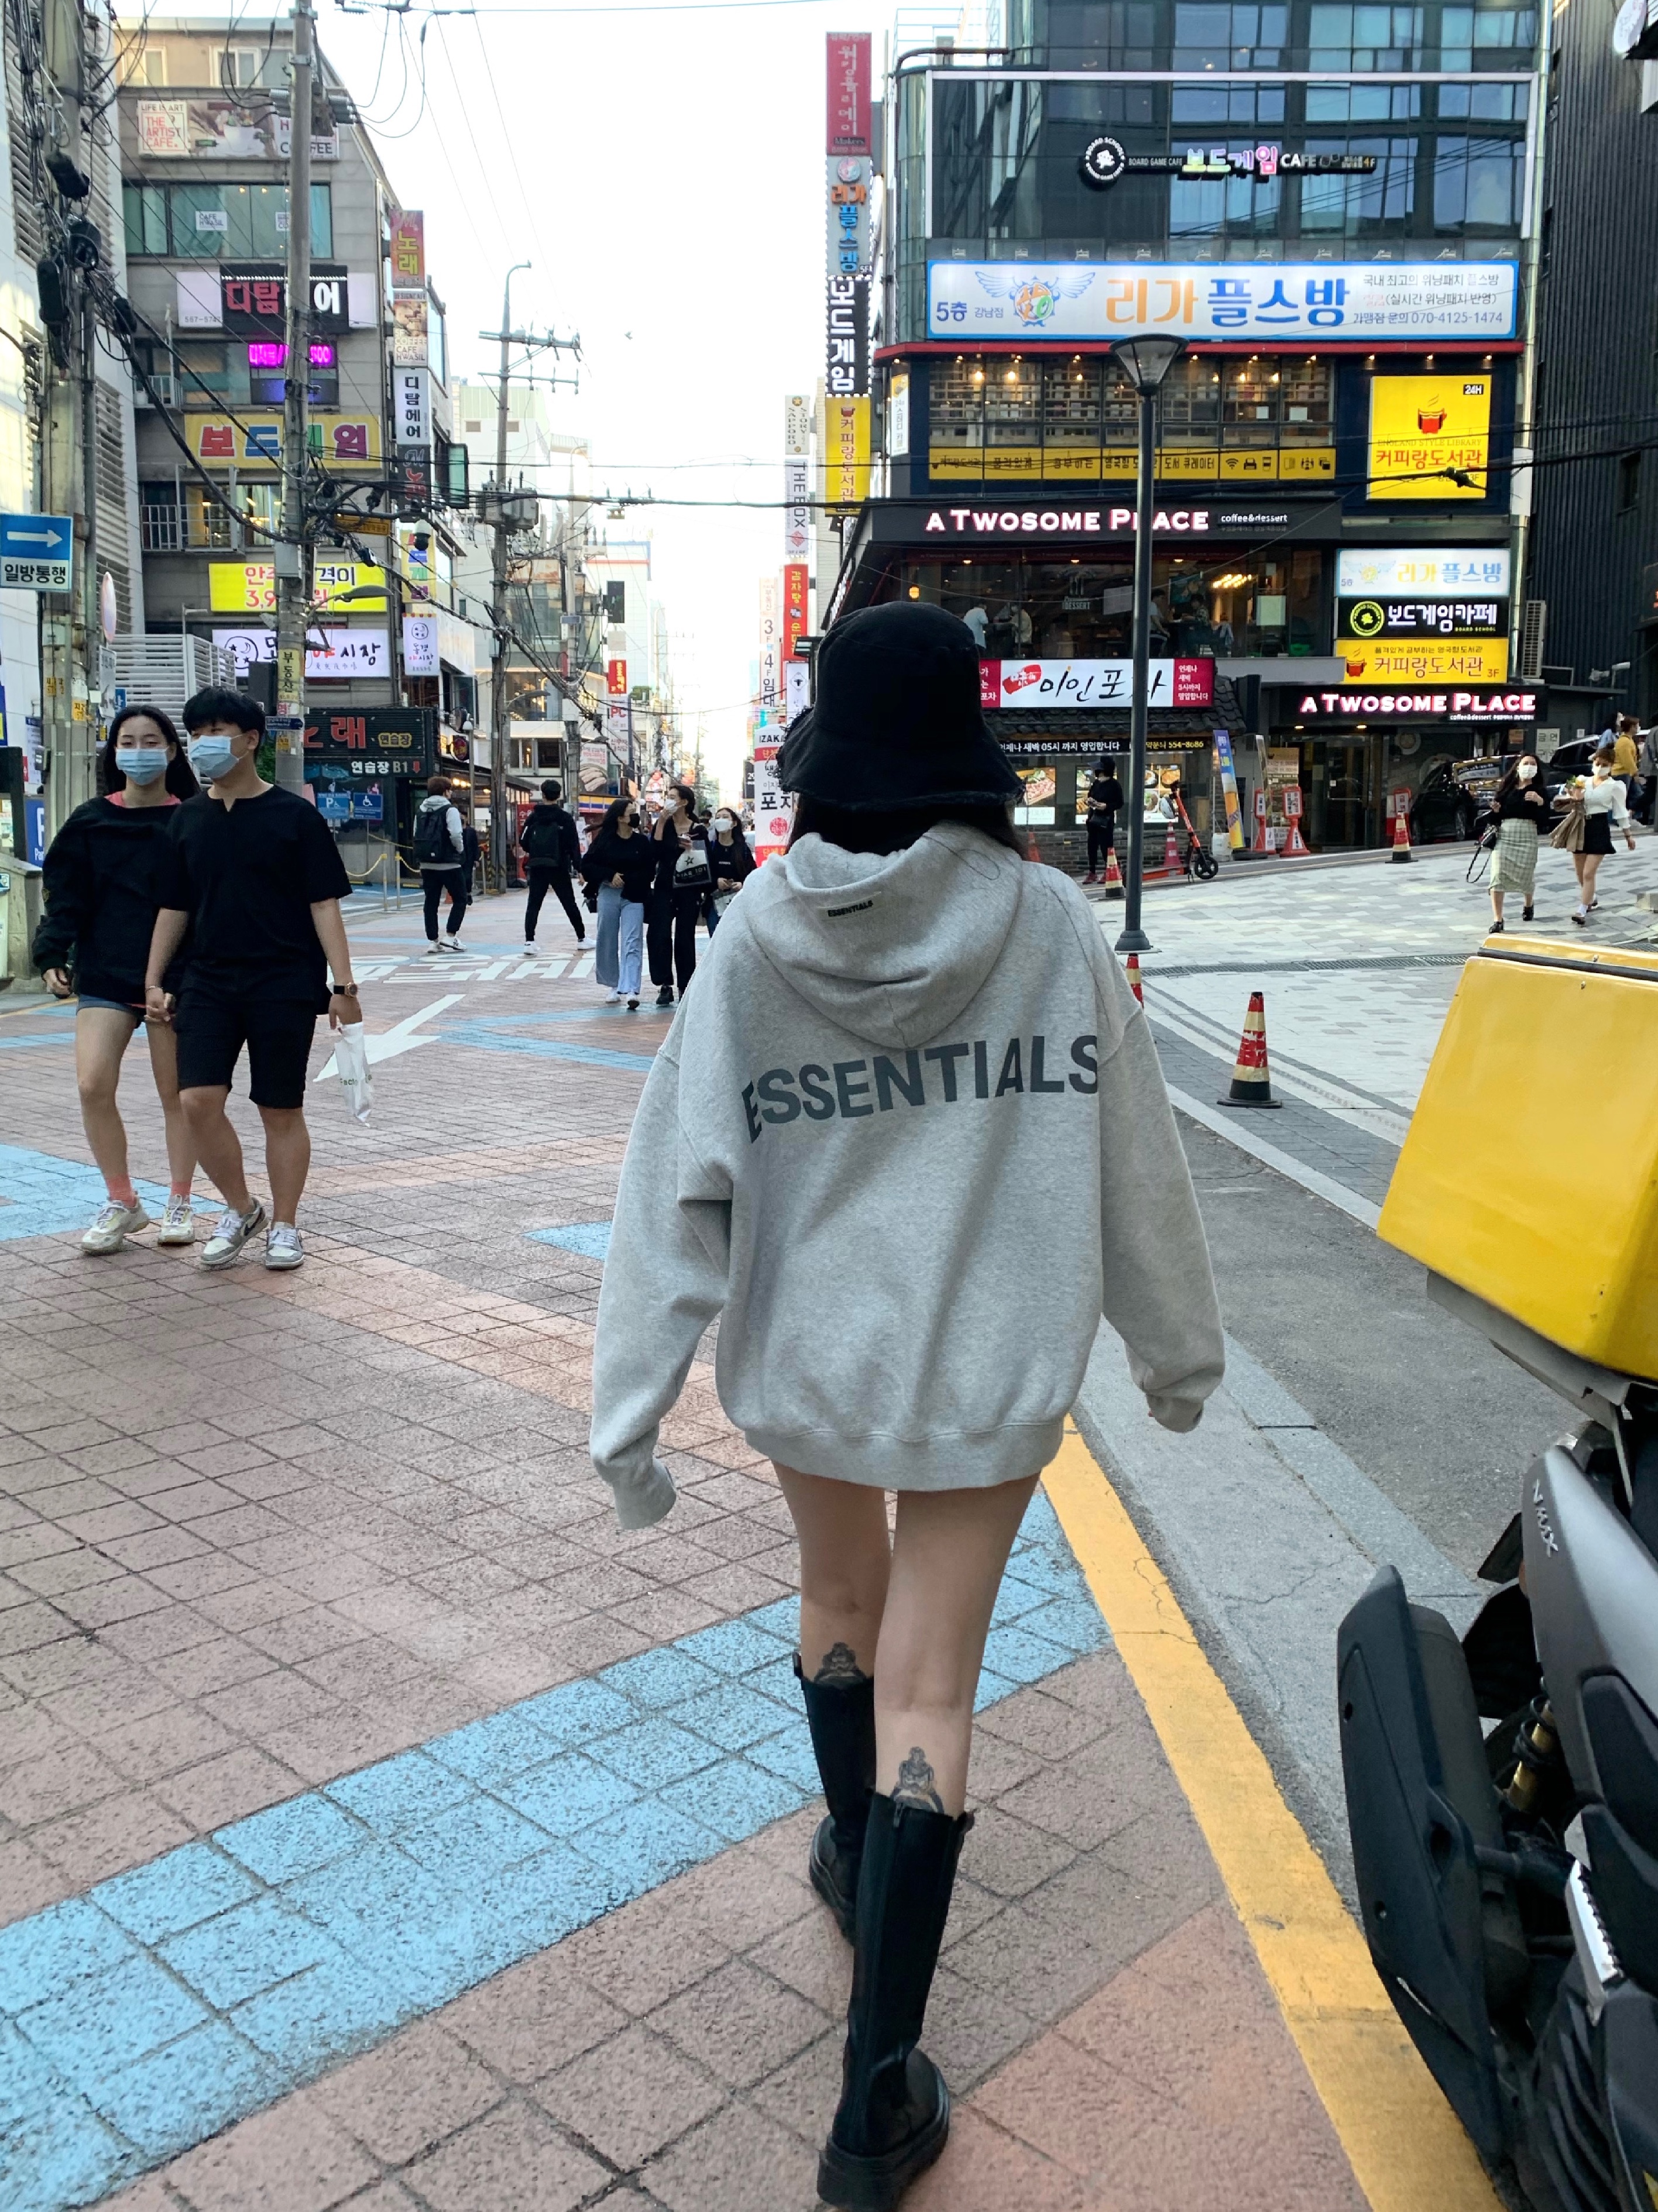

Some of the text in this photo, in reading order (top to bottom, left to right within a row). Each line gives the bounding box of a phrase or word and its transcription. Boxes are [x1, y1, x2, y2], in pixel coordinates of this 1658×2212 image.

[146, 117, 165, 126] THE
[146, 127, 181, 137] ARTIST
[280, 142, 332, 154] CFEE
[1128, 157, 1182, 166] BOARD GAME CAFE
[1182, 146, 1278, 175] 보드게임
[1281, 153, 1316, 167] CAFE
[397, 229, 418, 276] 노래
[1364, 274, 1384, 286] 국내
[1387, 274, 1418, 286] 최고의
[1422, 274, 1463, 286] 위닝패치
[225, 281, 341, 314] 디탐어
[1385, 293, 1422, 306] (실시간
[1425, 293, 1467, 305] 위닝패치
[936, 301, 967, 322] 5층
[974, 307, 1004, 319] 강남점
[1353, 311, 1503, 324] 가맹점 문의 070-4125-1474
[830, 281, 856, 391] 보드게임
[396, 353, 425, 361] HWASIL
[1465, 385, 1482, 394] 24H
[404, 376, 421, 438] 디탐헤어
[787, 407, 796, 445] SAPPORO
[199, 425, 368, 460] 보드임
[1183, 456, 1215, 469] 큐레이터
[1376, 449, 1482, 470] 커피랑도서관
[794, 461, 805, 492] THE
[926, 511, 945, 531] A
[950, 509, 1101, 531] TWOSOME
[5, 564, 66, 584] 일방통행
[1388, 604, 1498, 633] 보드게임카페
[1374, 657, 1499, 678] 커피랑도서관 3F
[1300, 693, 1536, 712] A TWOSOME PLACE
[379, 733, 411, 747] 연습장
[1062, 741, 1078, 751] 까지
[1080, 741, 1120, 751] 영업합니다
[351, 761, 408, 774] 연습장 B1
[827, 899, 874, 918] ESSENTIALS
[741, 1035, 1098, 1144] ESSENTIALS
